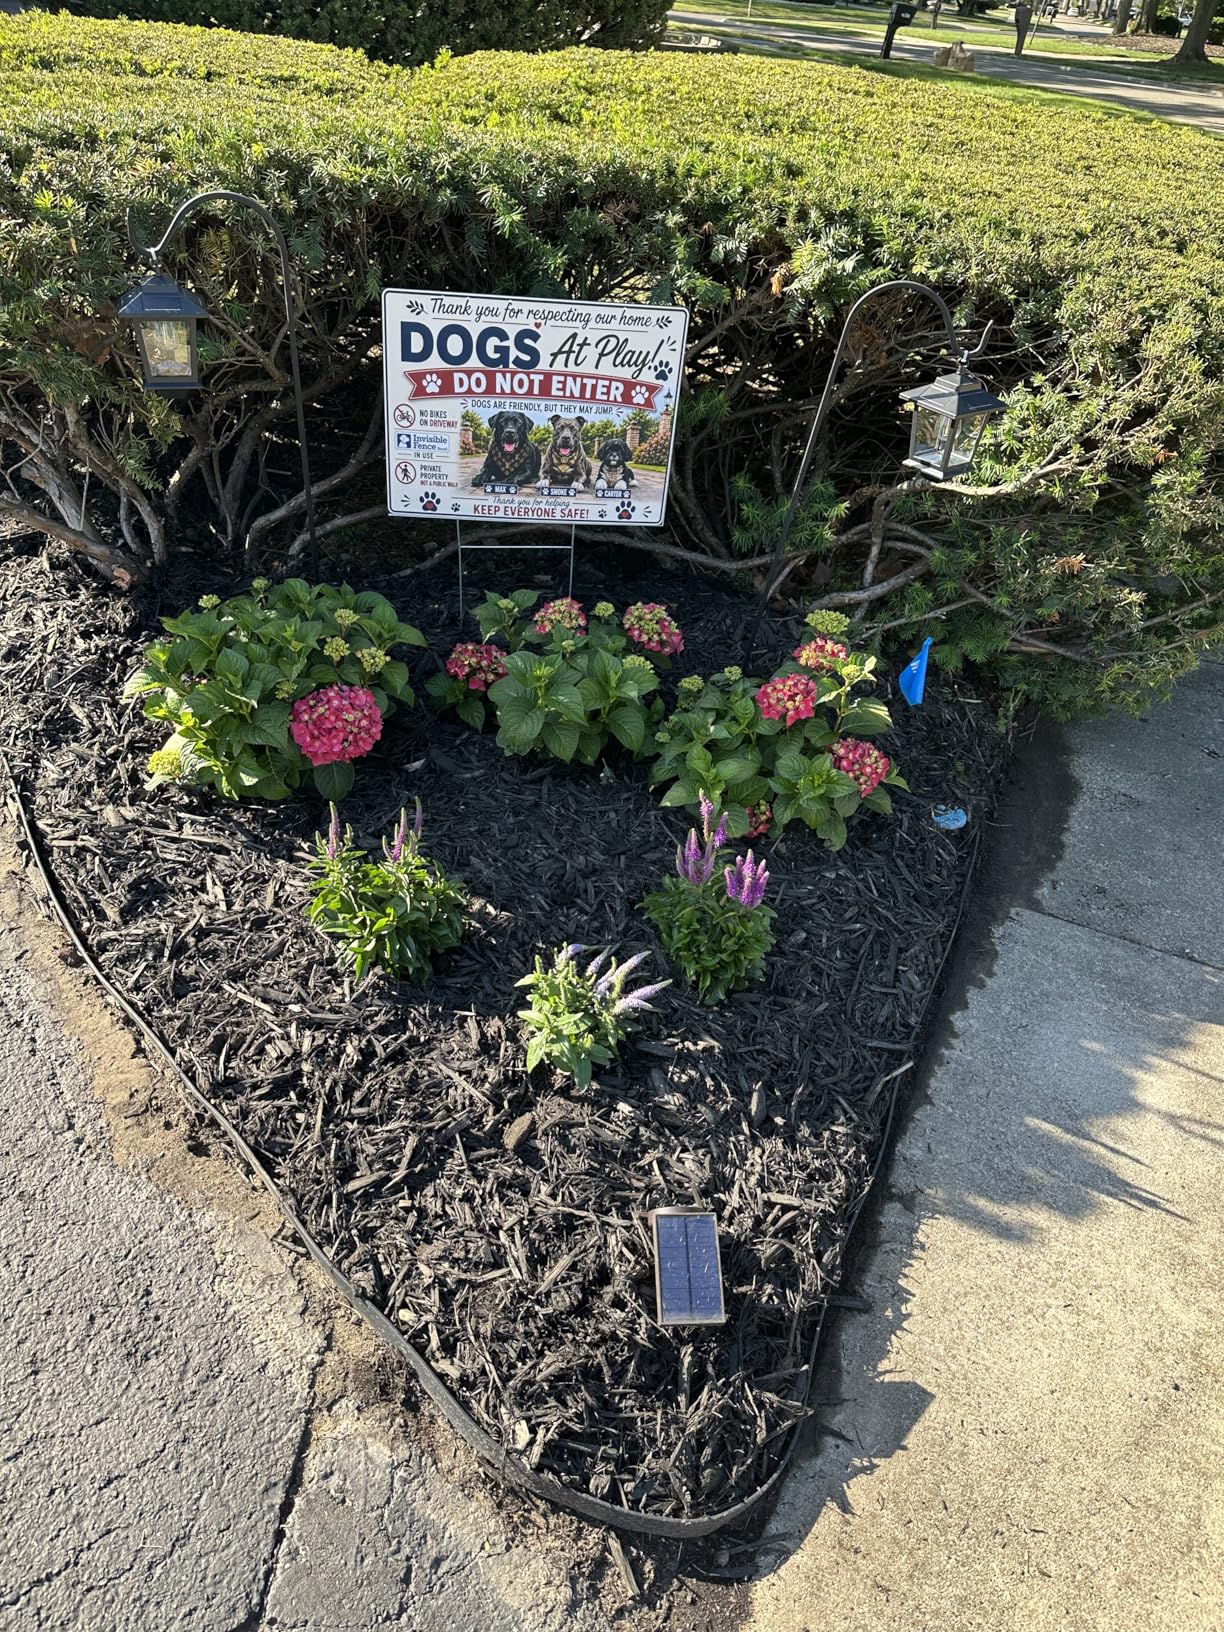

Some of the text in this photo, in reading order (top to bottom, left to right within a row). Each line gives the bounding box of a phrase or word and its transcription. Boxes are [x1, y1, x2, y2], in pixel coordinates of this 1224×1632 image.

[431, 298, 652, 329] Thank you for respecting our home
[401, 321, 665, 380] DOGS At Play!
[453, 372, 624, 403] DO NOT ENTER
[471, 399, 614, 415] DOGS ARE FRIENDLY, BUT THEY MAY JUMP.
[419, 409, 448, 419] NO BIKES
[419, 418, 458, 429] ON DRIVEWAY
[413, 434, 448, 444] Invisible
[413, 442, 436, 451] Fence
[420, 472, 449, 481] PROPERTY
[494, 485, 506, 493] MAX
[550, 487, 569, 496] SMOKE
[493, 496, 570, 509] Thank you for helping
[473, 504, 589, 519] KEEP EVERYONE SAFE!
